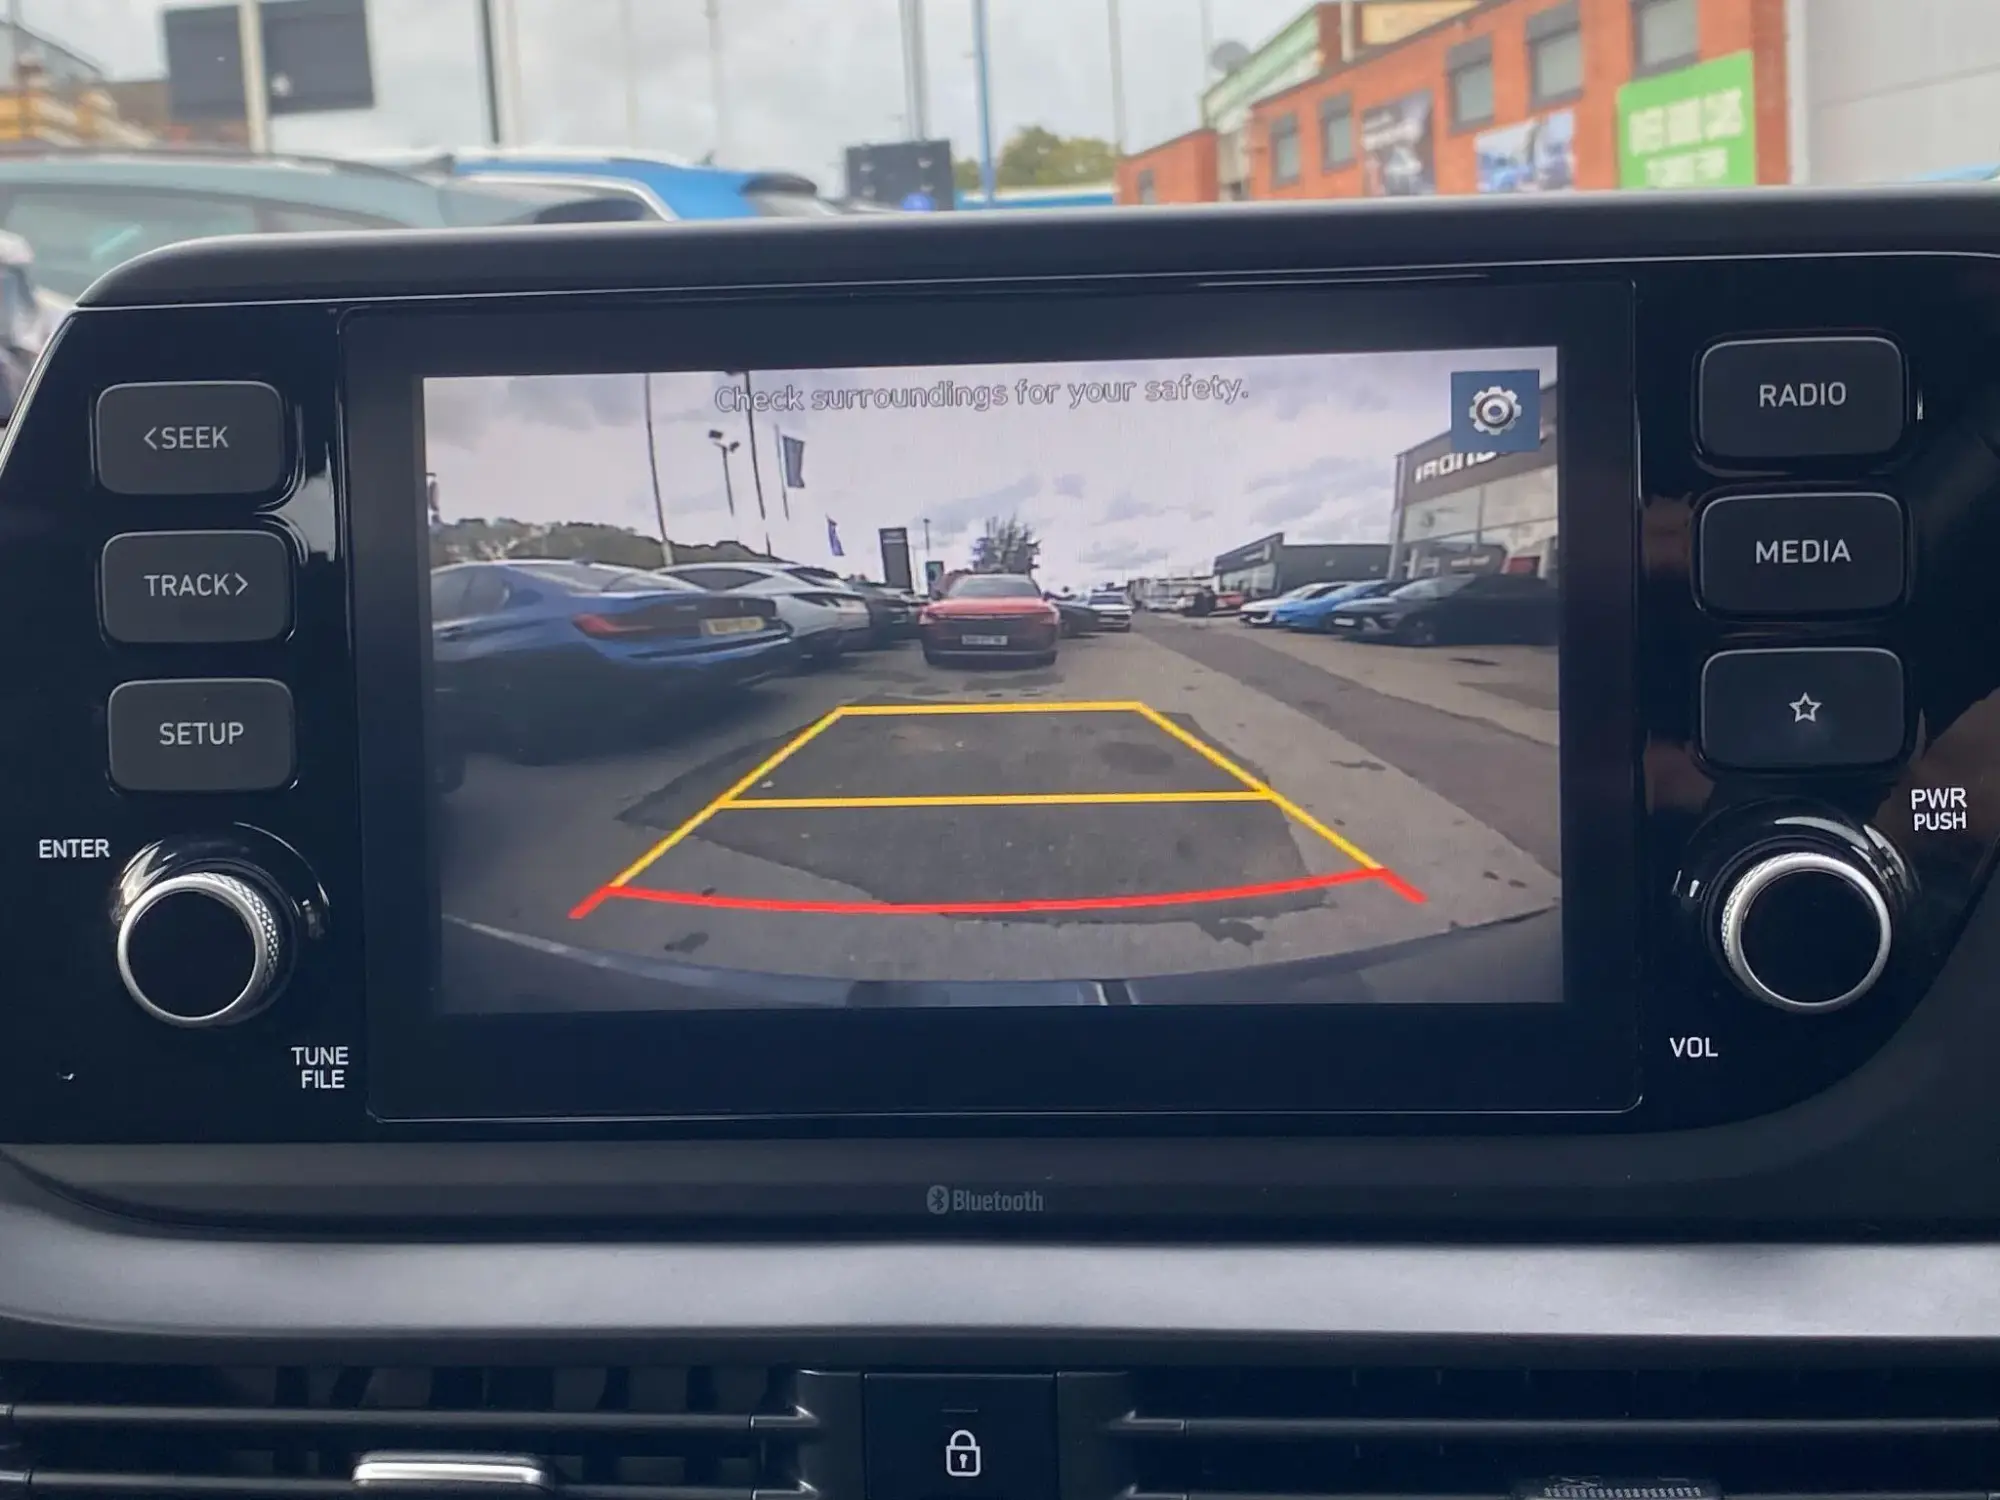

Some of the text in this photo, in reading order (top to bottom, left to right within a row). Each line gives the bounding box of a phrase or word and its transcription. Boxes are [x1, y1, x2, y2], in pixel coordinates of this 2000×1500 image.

[714, 373, 1250, 413] Check surroundings for your safety.
[1759, 381, 1847, 408] RADIO
[1755, 538, 1852, 564] MEDIA
[159, 721, 244, 746] SETUP
[1911, 787, 1968, 810] PWR
[1913, 811, 1967, 831] PUSH
[38, 838, 111, 859] ENTER
[290, 1046, 349, 1066] TUNE
[1669, 1036, 1719, 1058] VOL
[301, 1069, 345, 1089] FILE
[952, 1189, 1044, 1212] Bluetooth
